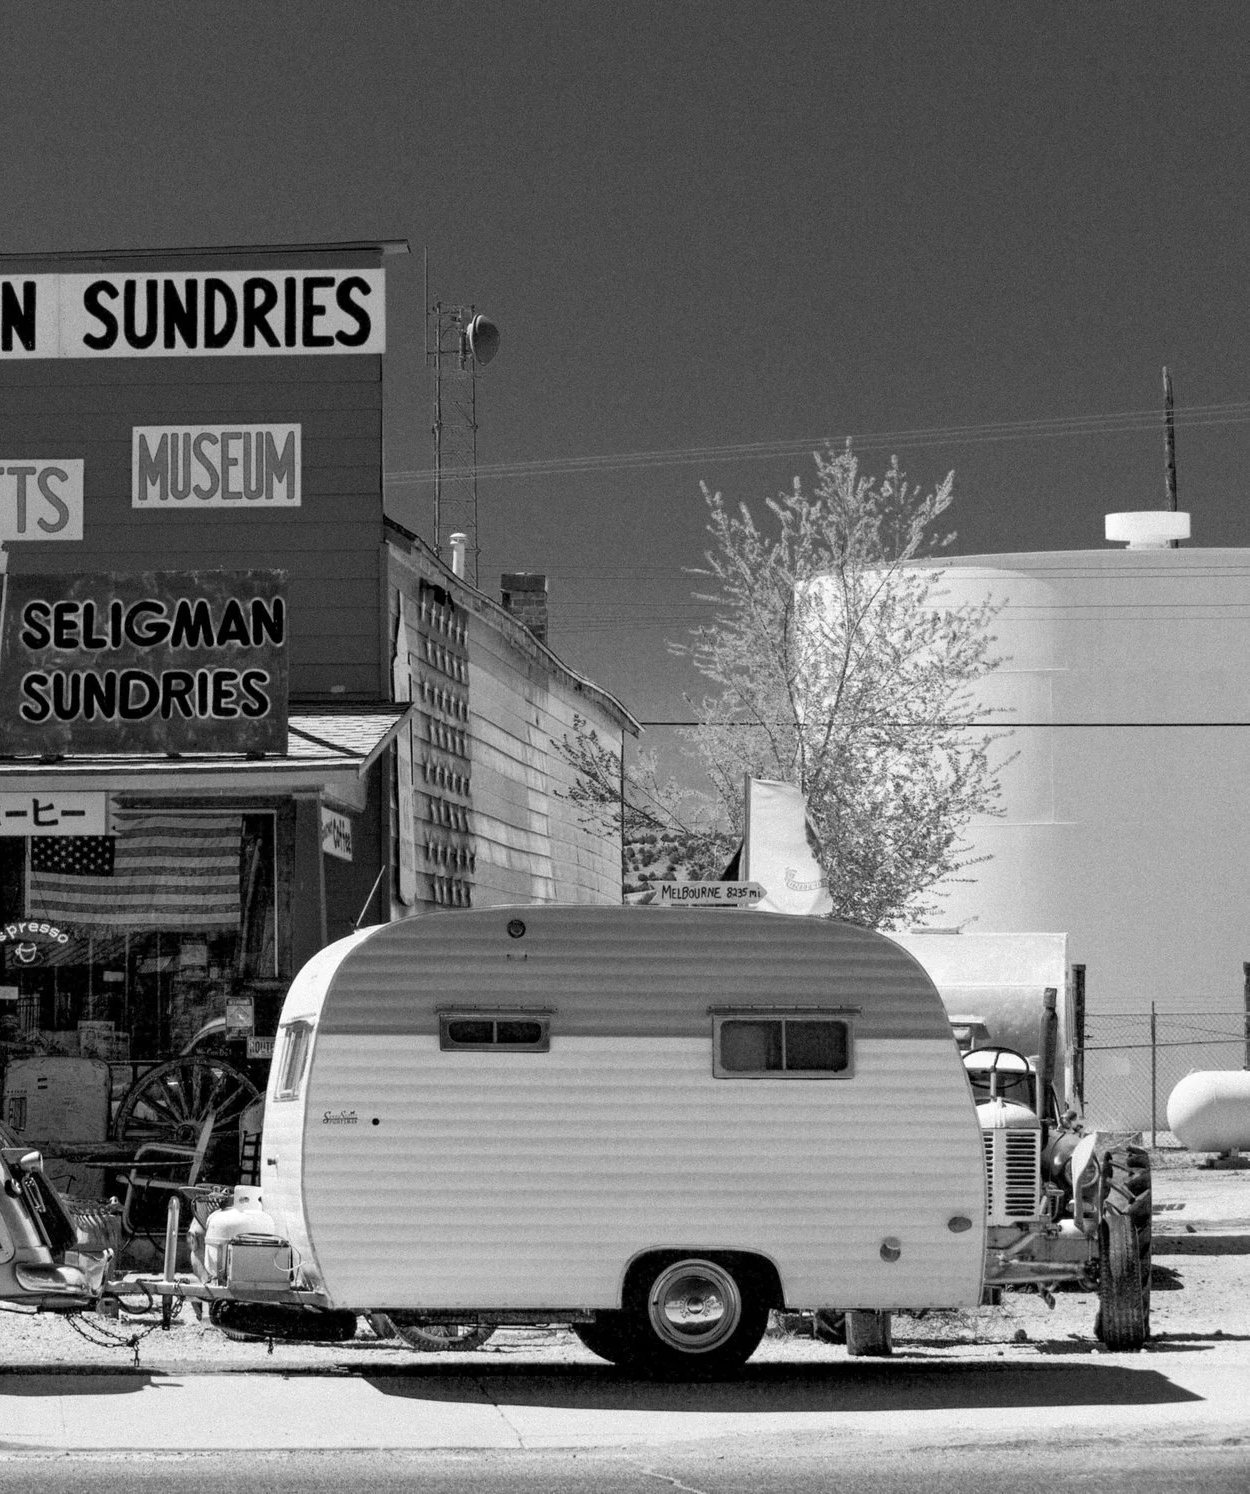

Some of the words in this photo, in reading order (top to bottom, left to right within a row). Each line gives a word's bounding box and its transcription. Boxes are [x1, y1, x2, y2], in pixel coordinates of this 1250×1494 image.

[82, 277, 372, 350] SUNDRIES
[138, 431, 295, 500] MUSEUM
[21, 597, 285, 650] SELIGMAN
[20, 668, 270, 722] SUNDRIES
[662, 885, 721, 899] MELBOURNE
